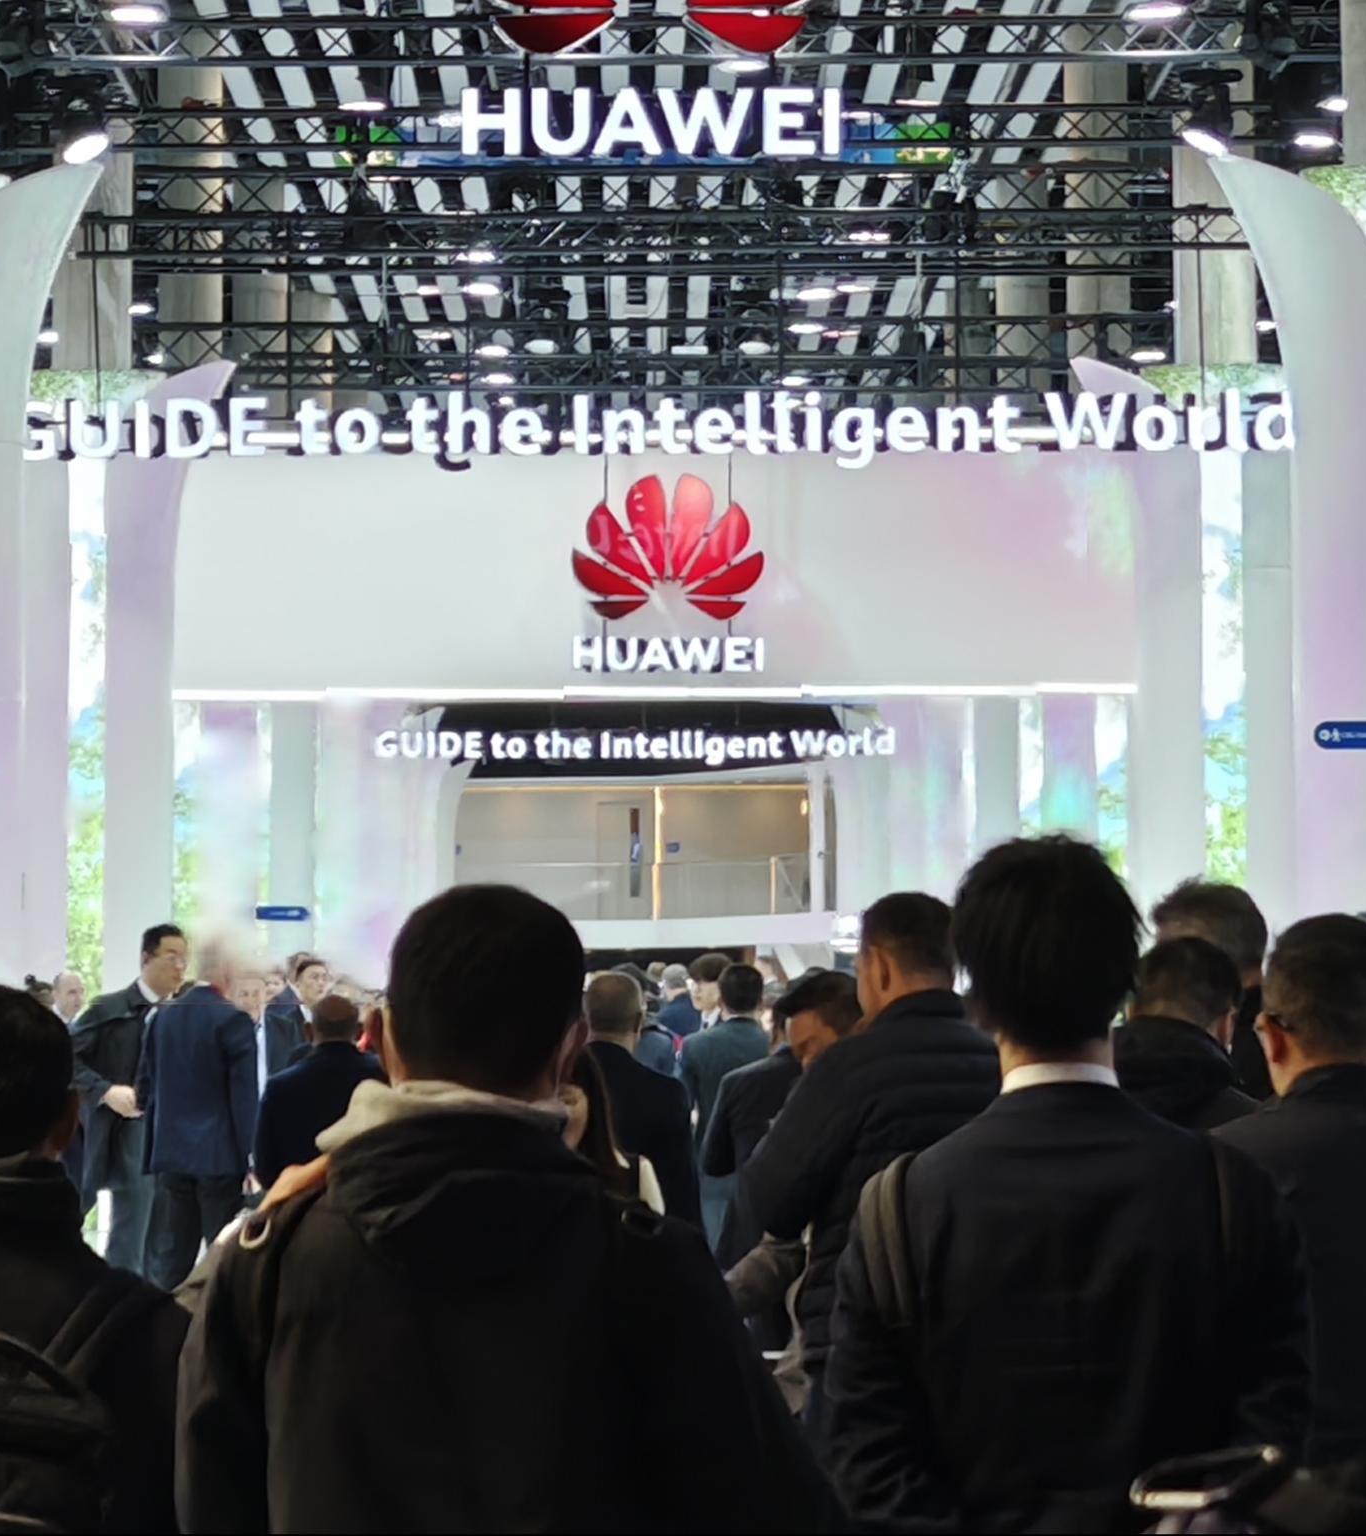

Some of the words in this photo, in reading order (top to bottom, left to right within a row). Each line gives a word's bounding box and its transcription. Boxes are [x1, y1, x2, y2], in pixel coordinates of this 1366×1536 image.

[461, 86, 840, 157] HUAWEI
[22, 398, 268, 461] GUIDE
[296, 398, 380, 455] to
[408, 392, 543, 456] the
[573, 390, 1022, 469] Intelligent
[1044, 387, 1295, 453] World
[572, 636, 765, 673] HUAWEI
[375, 730, 483, 759] GUIDE
[491, 733, 528, 758] to
[535, 731, 591, 759] the
[600, 730, 784, 765] Intelligent
[791, 727, 896, 758] World
